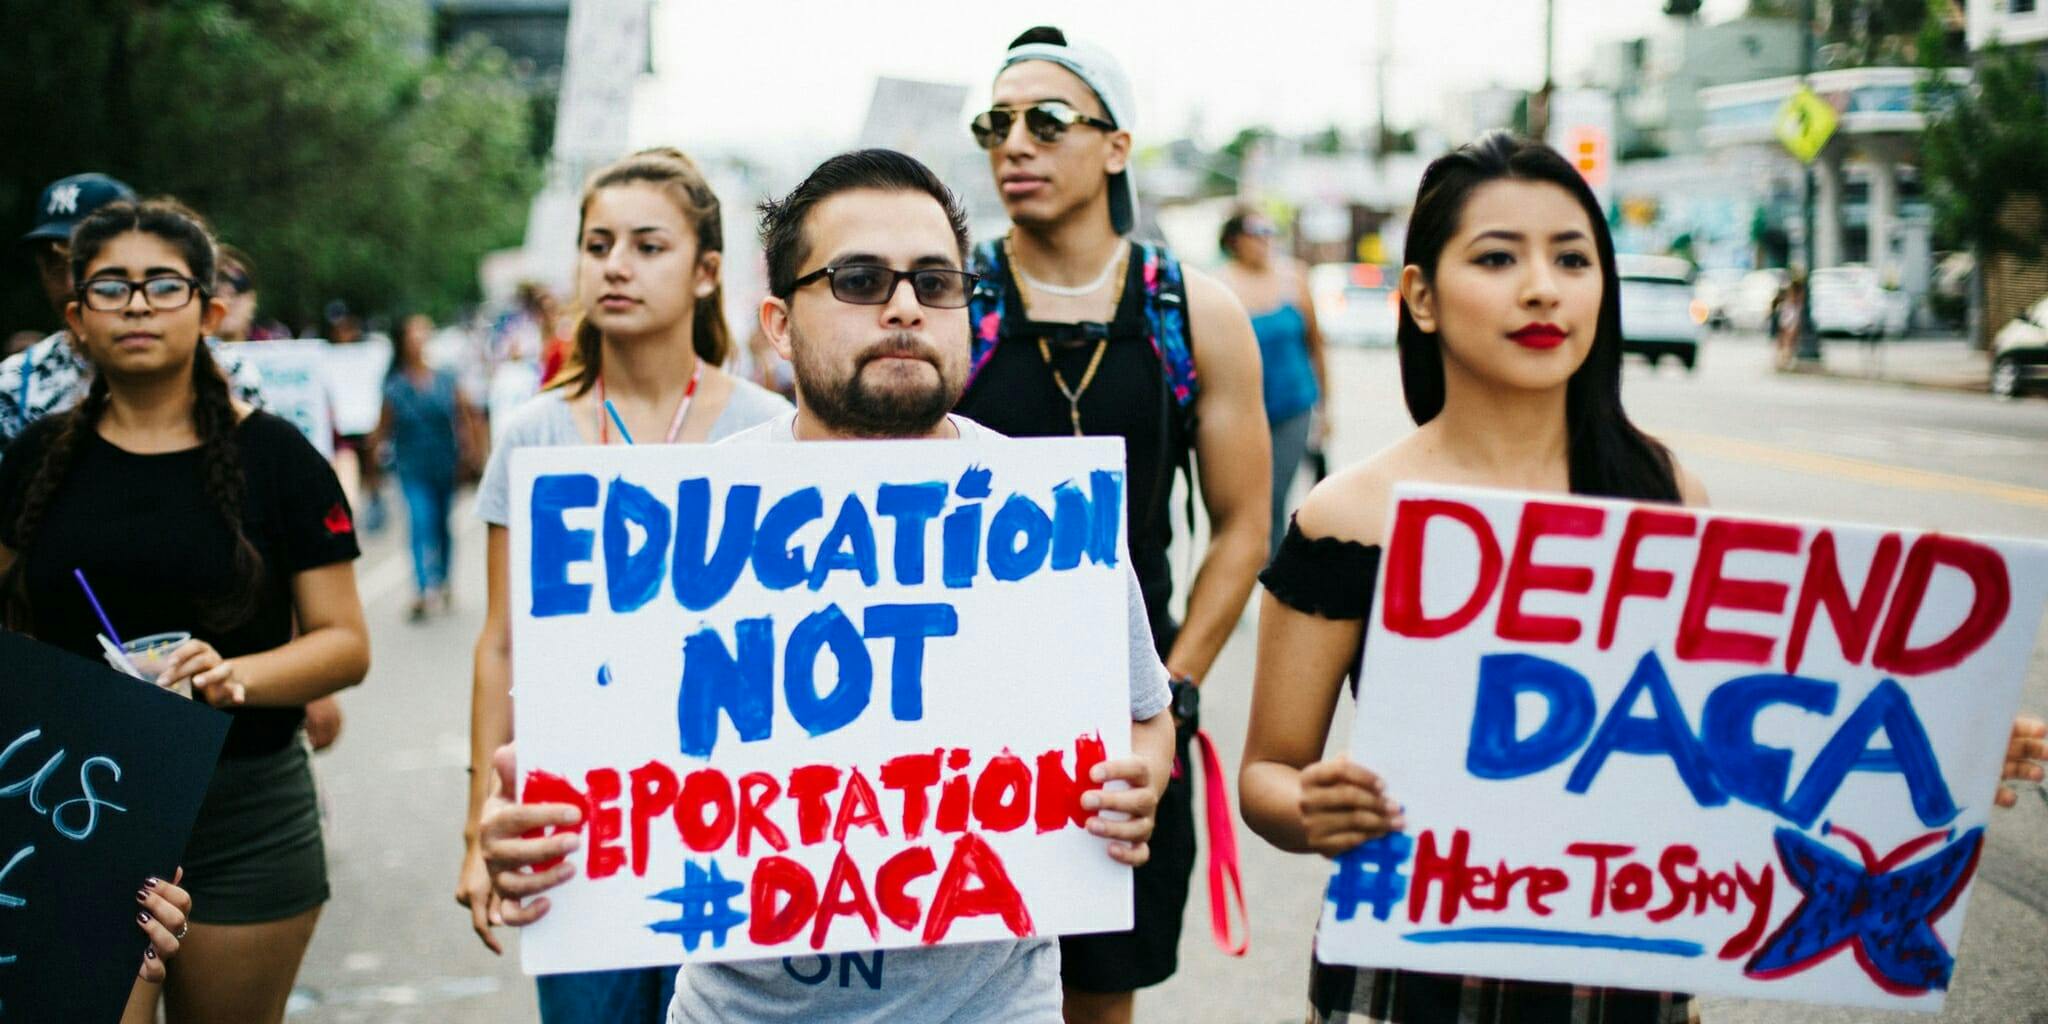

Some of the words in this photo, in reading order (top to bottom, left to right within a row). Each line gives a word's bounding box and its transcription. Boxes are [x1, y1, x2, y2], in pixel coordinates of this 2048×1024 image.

[1382, 498, 2010, 678] DEFEND
[678, 602, 958, 760] NOT
[1466, 648, 1956, 829] DACA
[646, 833, 1035, 952] #DACA
